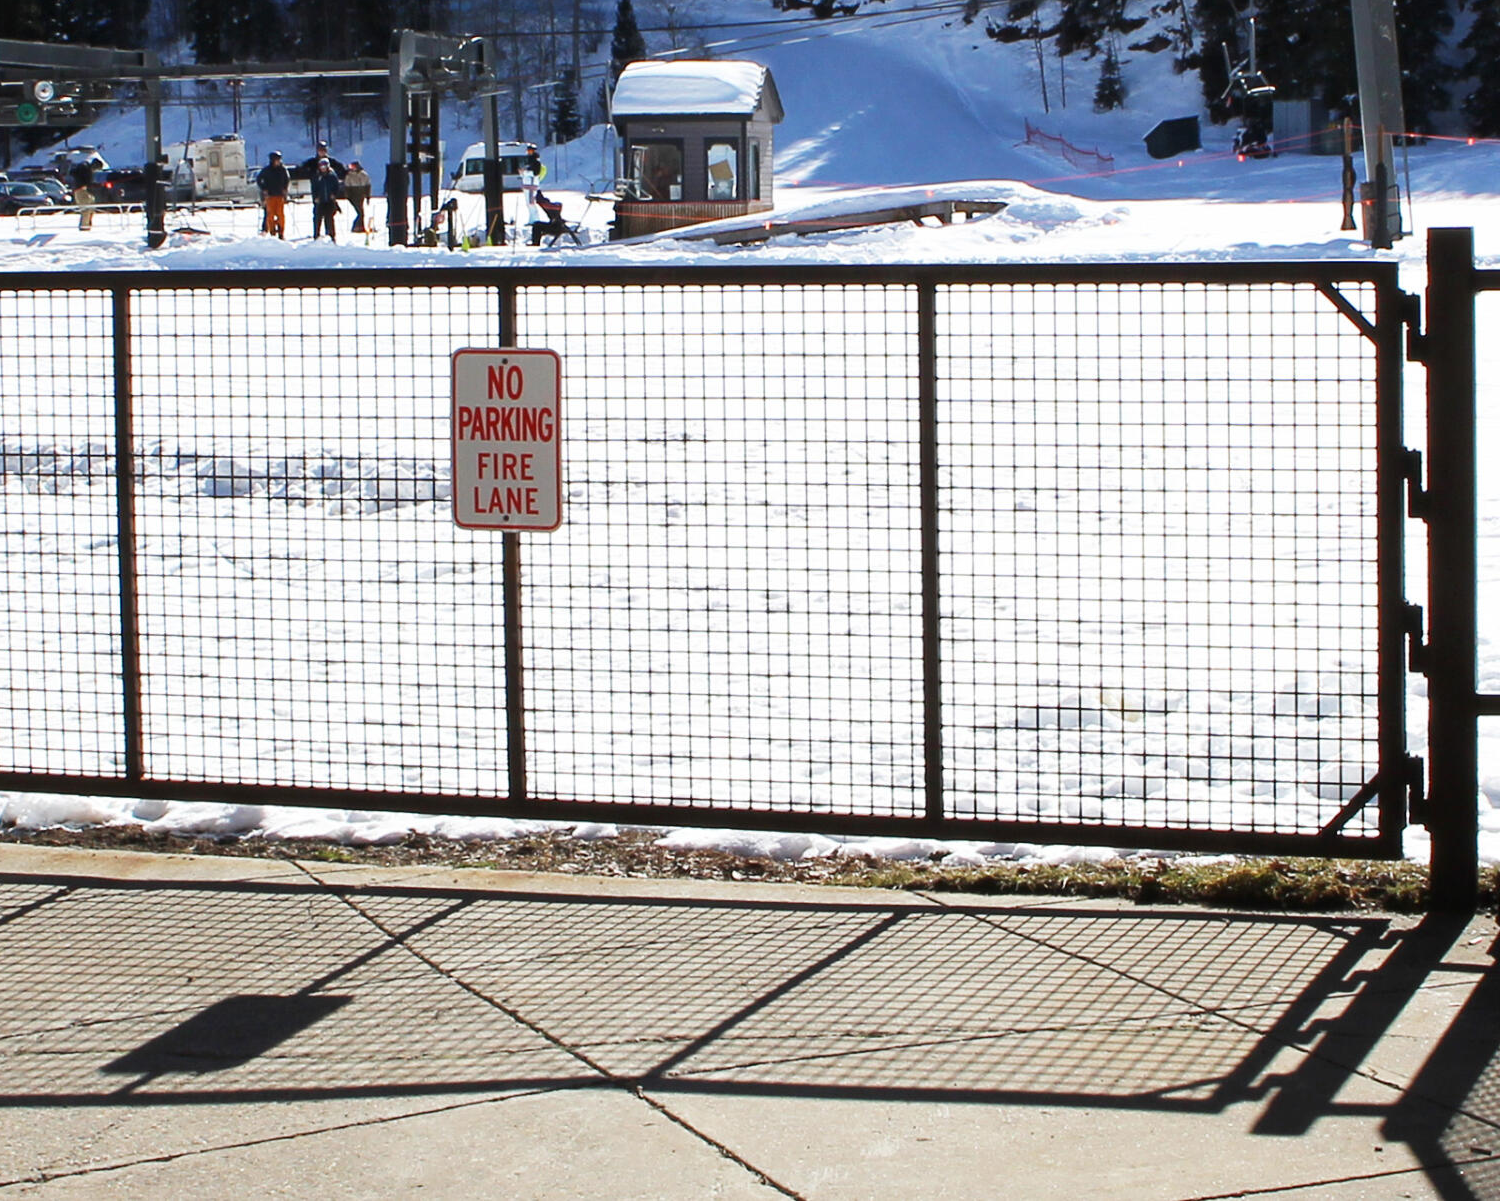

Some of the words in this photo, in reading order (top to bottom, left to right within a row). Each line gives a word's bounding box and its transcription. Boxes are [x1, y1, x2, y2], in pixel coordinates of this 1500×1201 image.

[488, 365, 523, 400] NO
[459, 406, 554, 442] PARKING
[478, 453, 534, 481] FIRE
[474, 486, 539, 515] LANE
